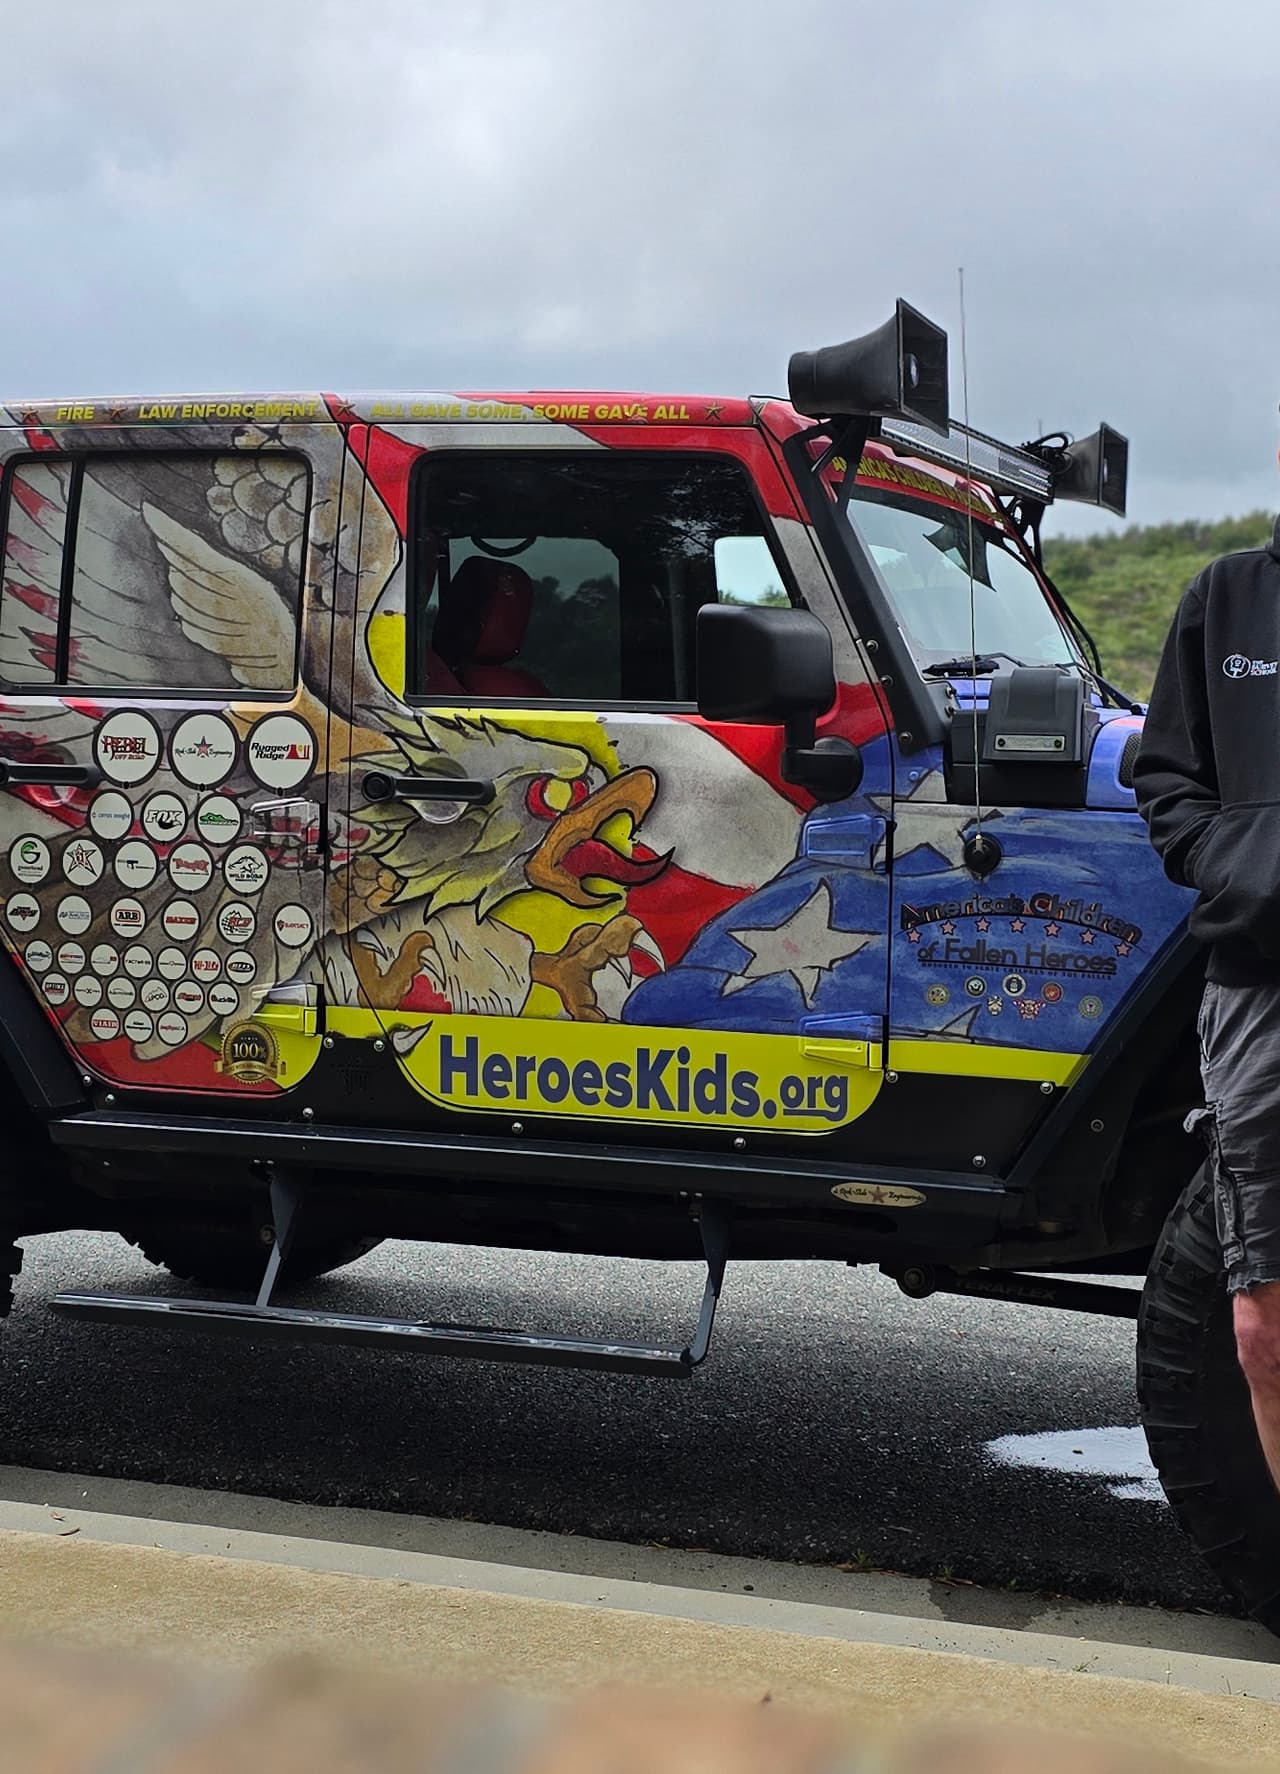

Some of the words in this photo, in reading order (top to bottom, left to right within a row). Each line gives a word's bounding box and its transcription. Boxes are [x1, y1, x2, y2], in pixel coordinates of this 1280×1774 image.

[56, 406, 96, 420] FIRE
[139, 404, 178, 419] LAW
[181, 401, 319, 418] ENFORCEMENT
[371, 403, 404, 417] ALL
[409, 403, 463, 418] GAVE
[466, 403, 528, 421] SOME,
[532, 404, 590, 419] SOME
[595, 404, 649, 419] GAVE
[653, 405, 690, 420] ALL
[250, 742, 290, 752] Rugged
[255, 751, 285, 761] Ridge
[145, 809, 183, 823] FOX
[118, 911, 139, 921] ARB
[901, 892, 1028, 931] American
[1025, 891, 1143, 946] Children
[917, 939, 940, 962] of
[944, 937, 1018, 966] Fallen
[1025, 942, 1118, 973] Heroes
[438, 1033, 850, 1122] HeroesKids.org
